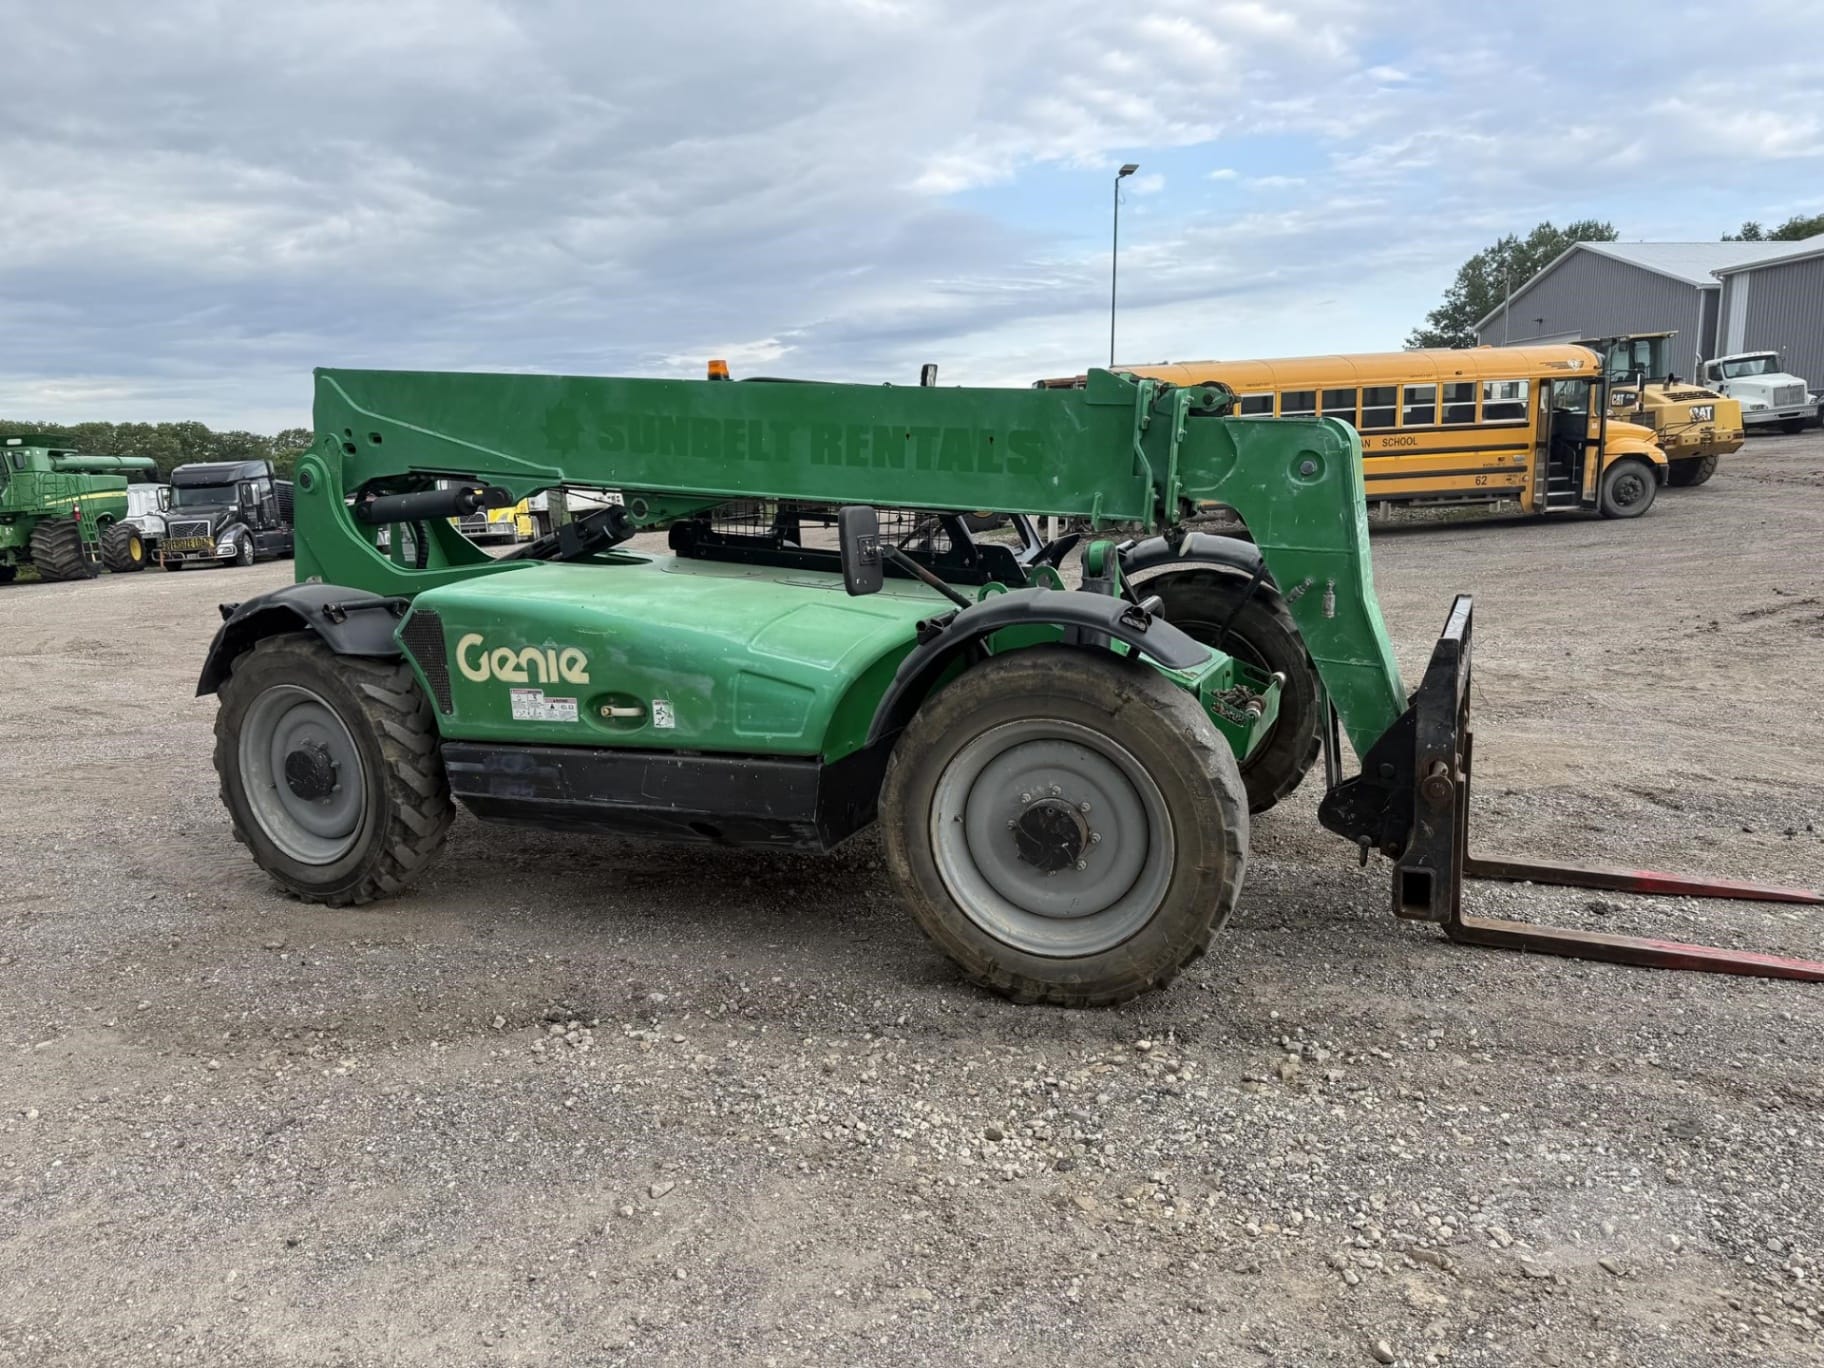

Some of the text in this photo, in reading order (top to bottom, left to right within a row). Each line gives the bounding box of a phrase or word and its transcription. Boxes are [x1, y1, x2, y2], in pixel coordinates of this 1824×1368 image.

[1611, 393, 1625, 406] CAT
[1689, 405, 1713, 421] CAT
[599, 413, 1043, 475] SUNBELT RENTALS
[1382, 436, 1418, 447] SCHOOL
[1475, 475, 1488, 486] 62
[456, 633, 590, 684] Genie
